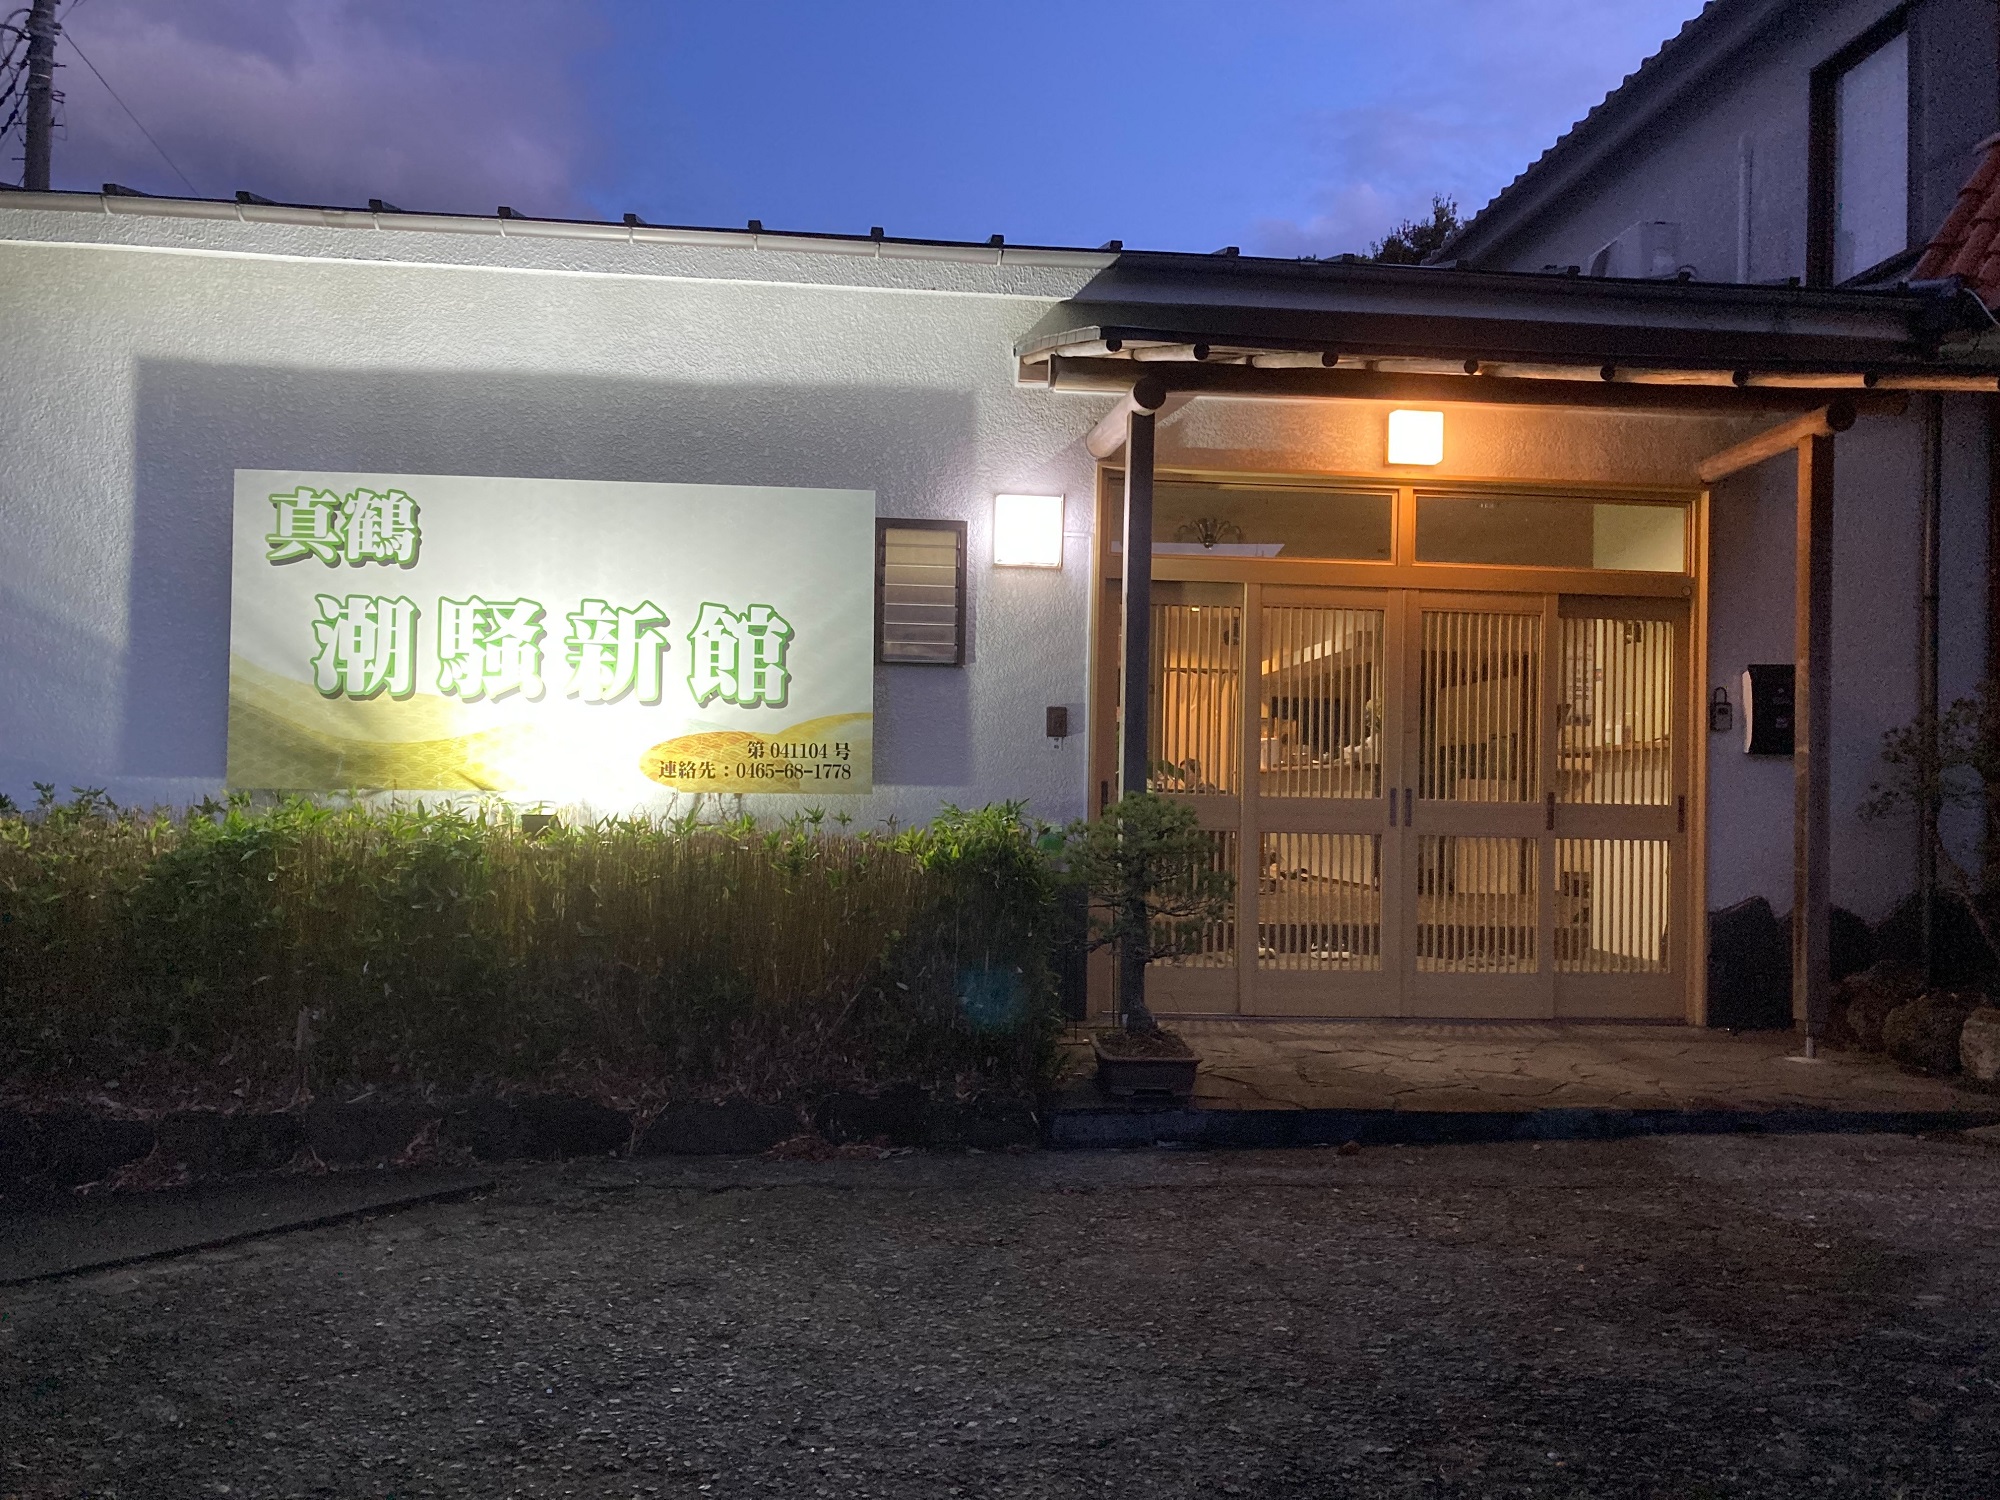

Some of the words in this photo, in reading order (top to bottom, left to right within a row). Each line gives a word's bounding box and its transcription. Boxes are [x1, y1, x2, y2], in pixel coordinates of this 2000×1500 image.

[265, 486, 422, 569] 真鶴
[310, 594, 795, 709] 潮騒新館
